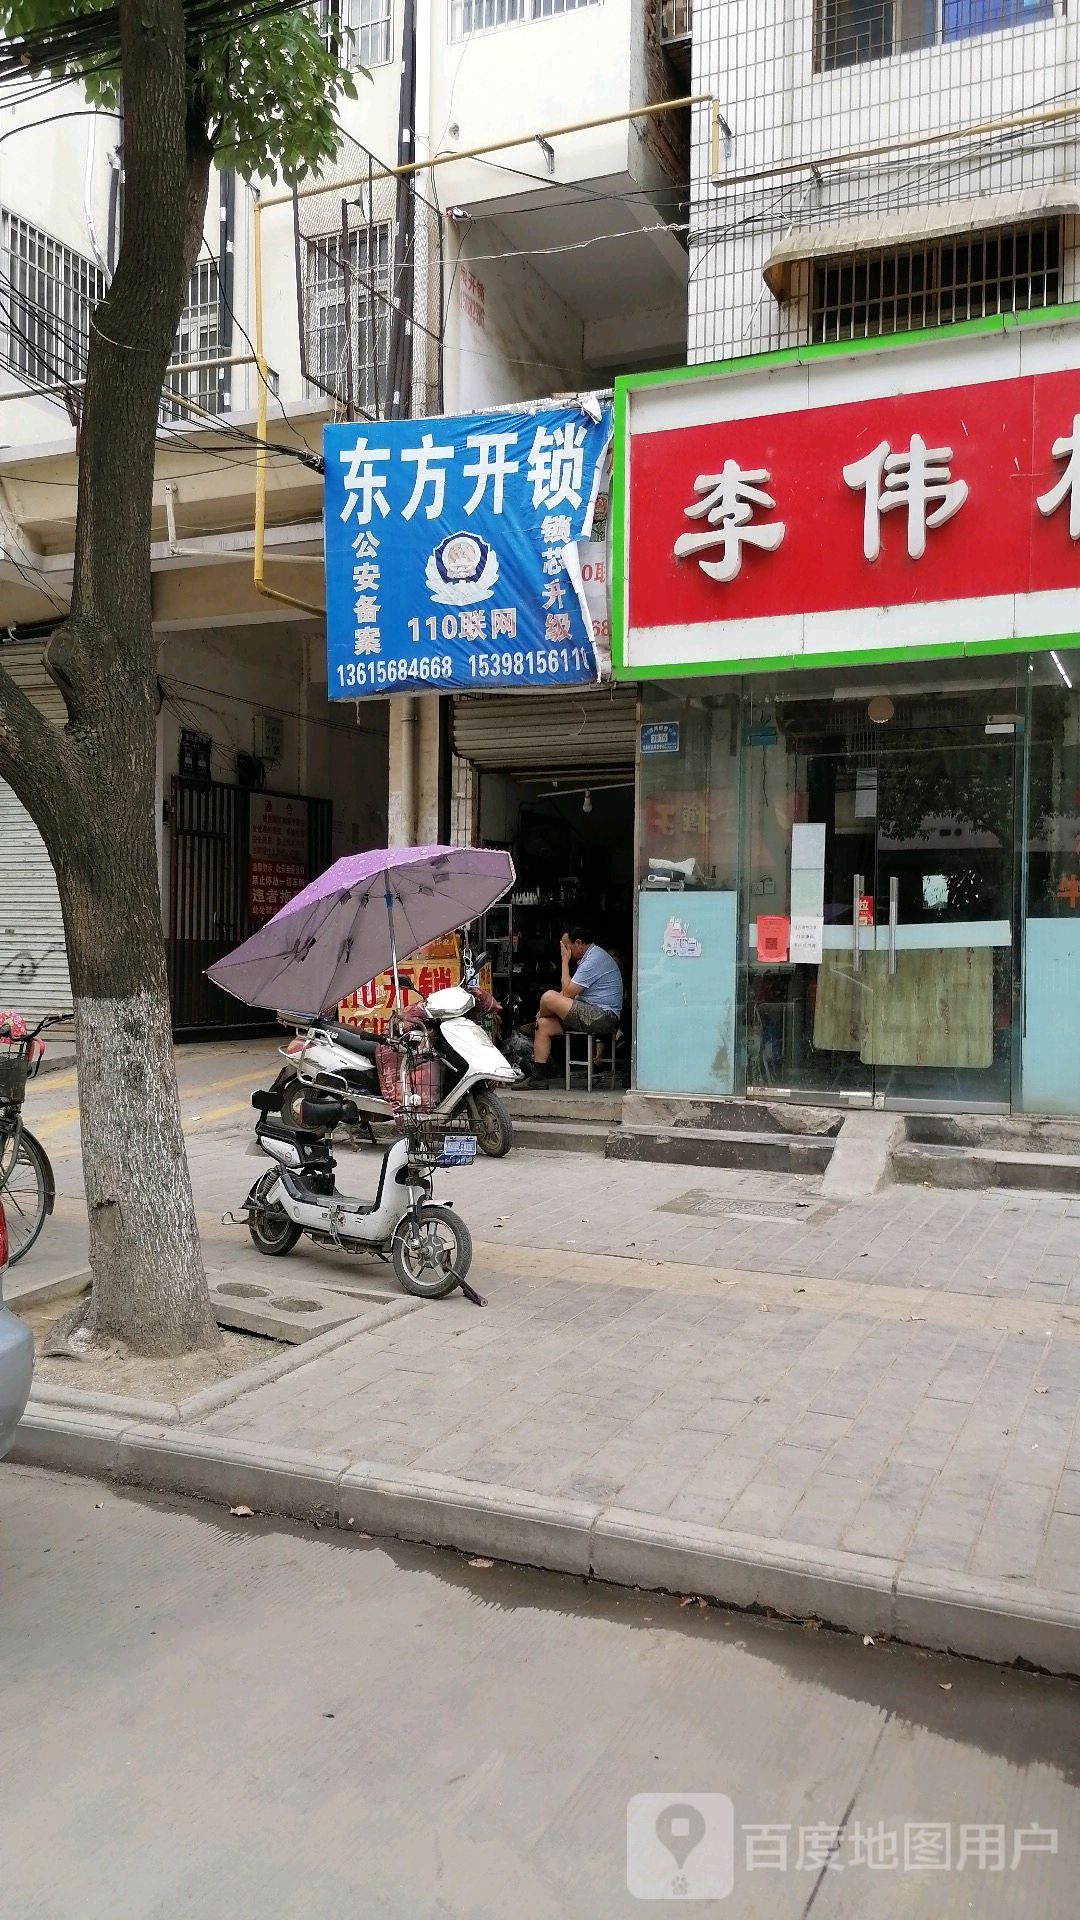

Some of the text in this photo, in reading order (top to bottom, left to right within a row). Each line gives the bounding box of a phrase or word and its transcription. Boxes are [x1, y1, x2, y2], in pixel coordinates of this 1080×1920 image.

[339, 422, 588, 526] 东方开锁
[352, 530, 382, 656] 公安备案
[407, 607, 517, 642] 110联网
[541, 514, 573, 642] 锁芯升级
[337, 655, 452, 687] 13615684668
